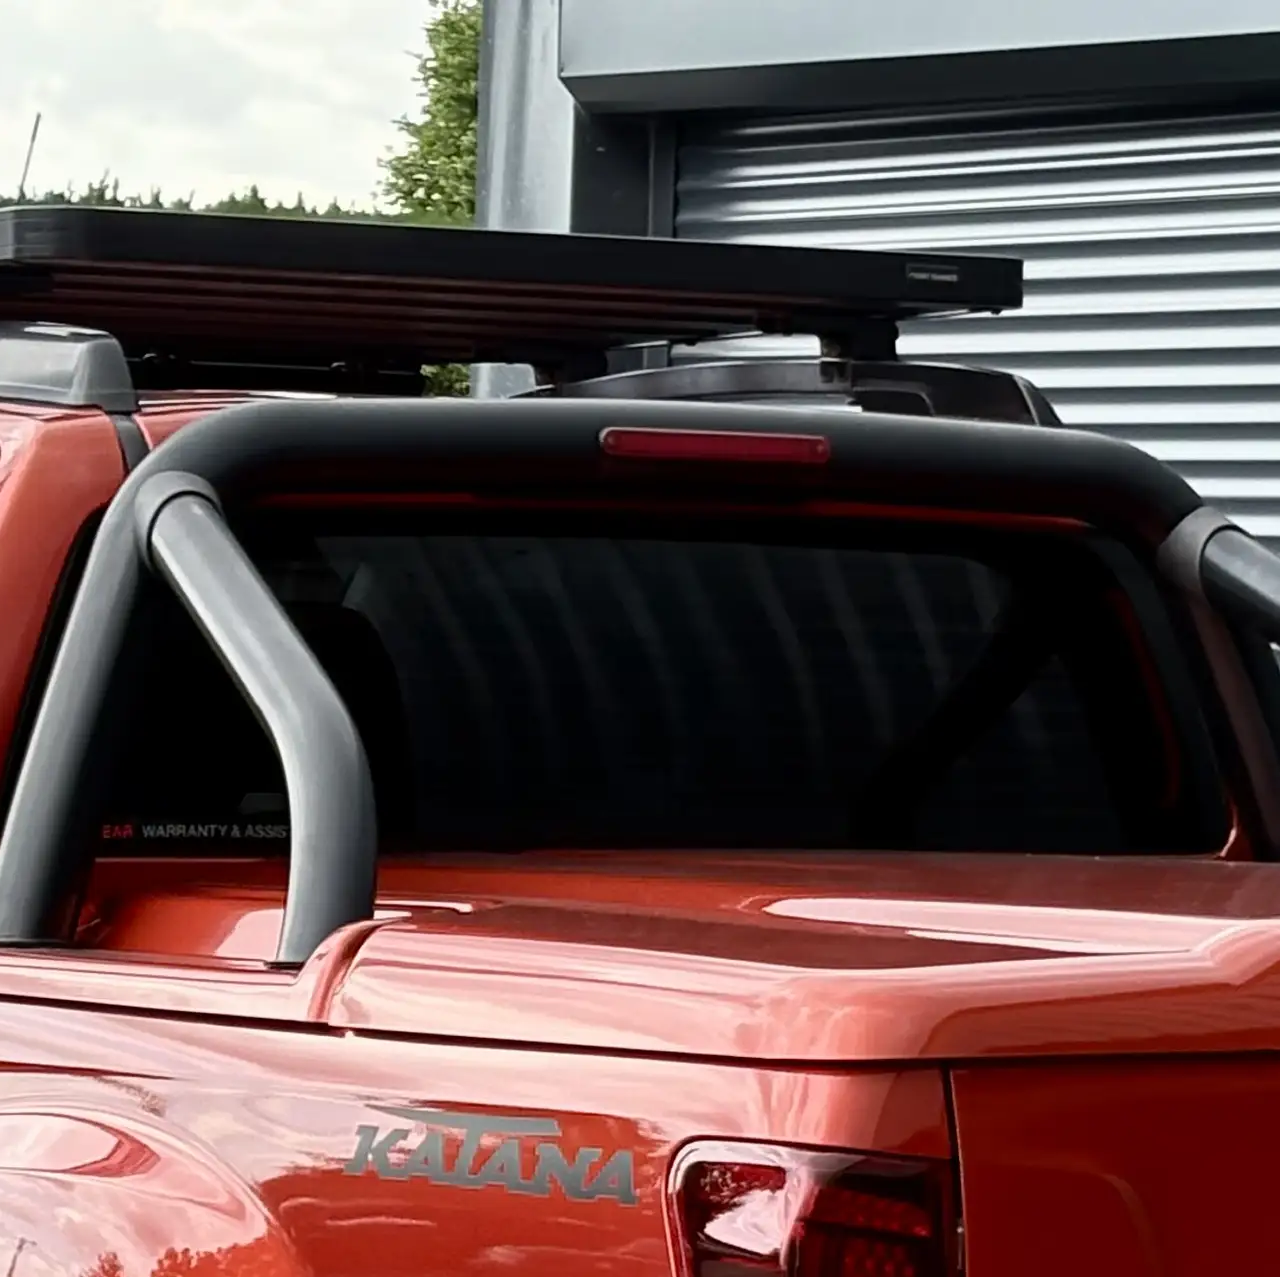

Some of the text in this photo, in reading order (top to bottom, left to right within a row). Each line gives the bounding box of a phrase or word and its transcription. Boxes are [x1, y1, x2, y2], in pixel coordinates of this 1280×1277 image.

[141, 824, 227, 838] WARRANTY
[231, 824, 241, 838] &
[341, 1103, 639, 1207] KATANA
